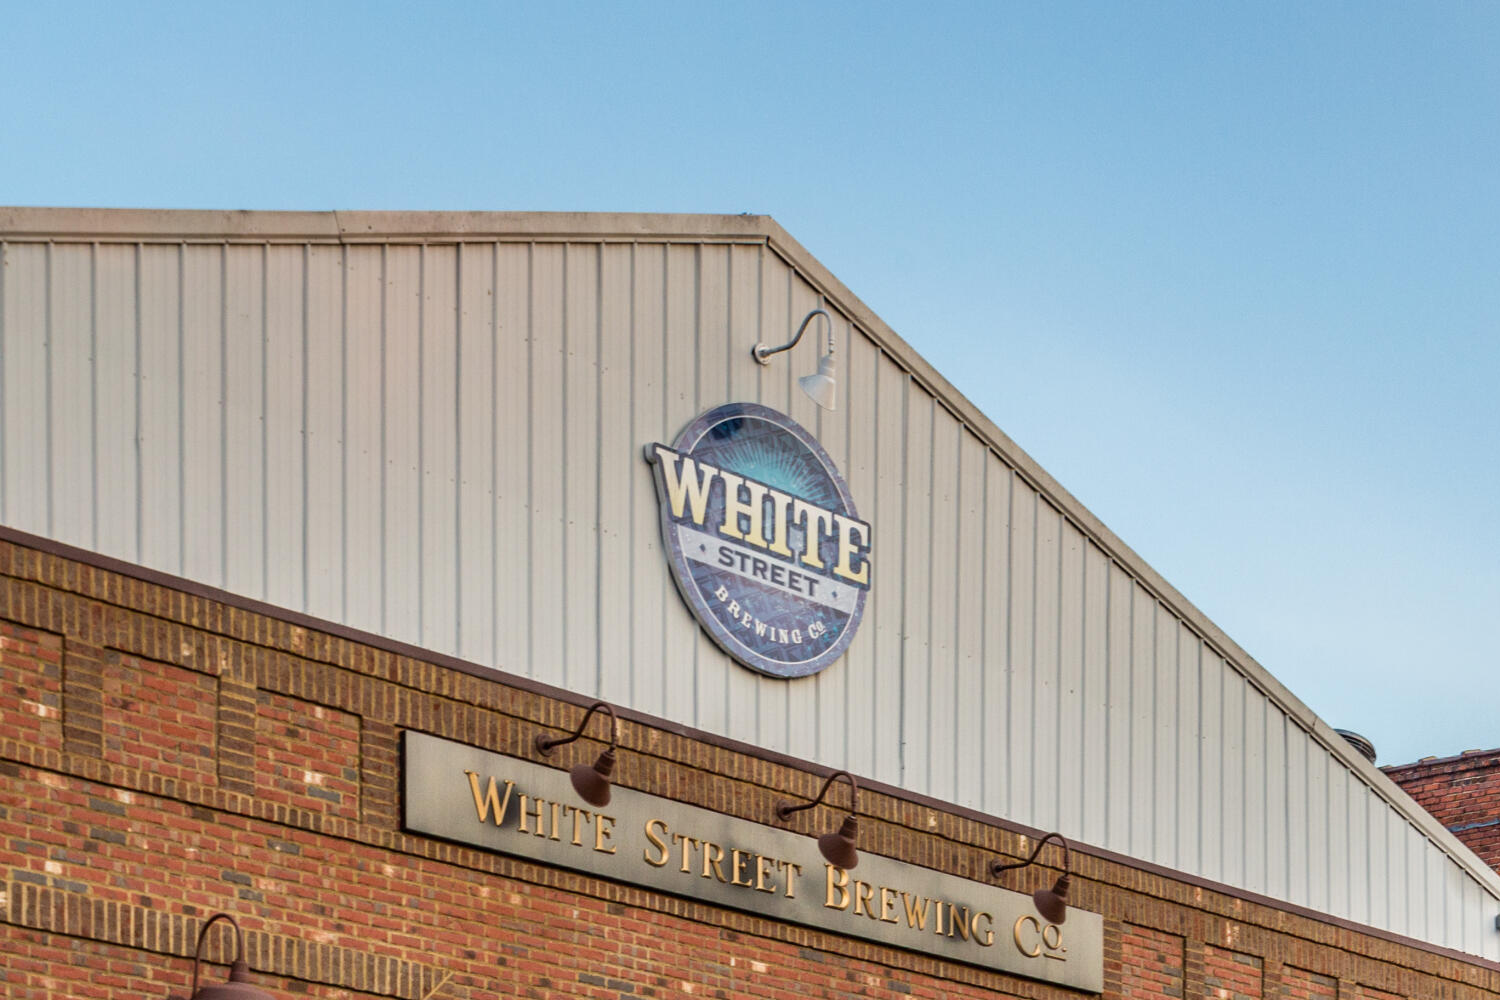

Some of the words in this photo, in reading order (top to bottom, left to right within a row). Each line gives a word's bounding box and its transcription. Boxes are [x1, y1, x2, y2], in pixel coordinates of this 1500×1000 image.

[655, 446, 869, 585] WHITE
[718, 546, 819, 596] STREET
[714, 585, 802, 644] BREWING
